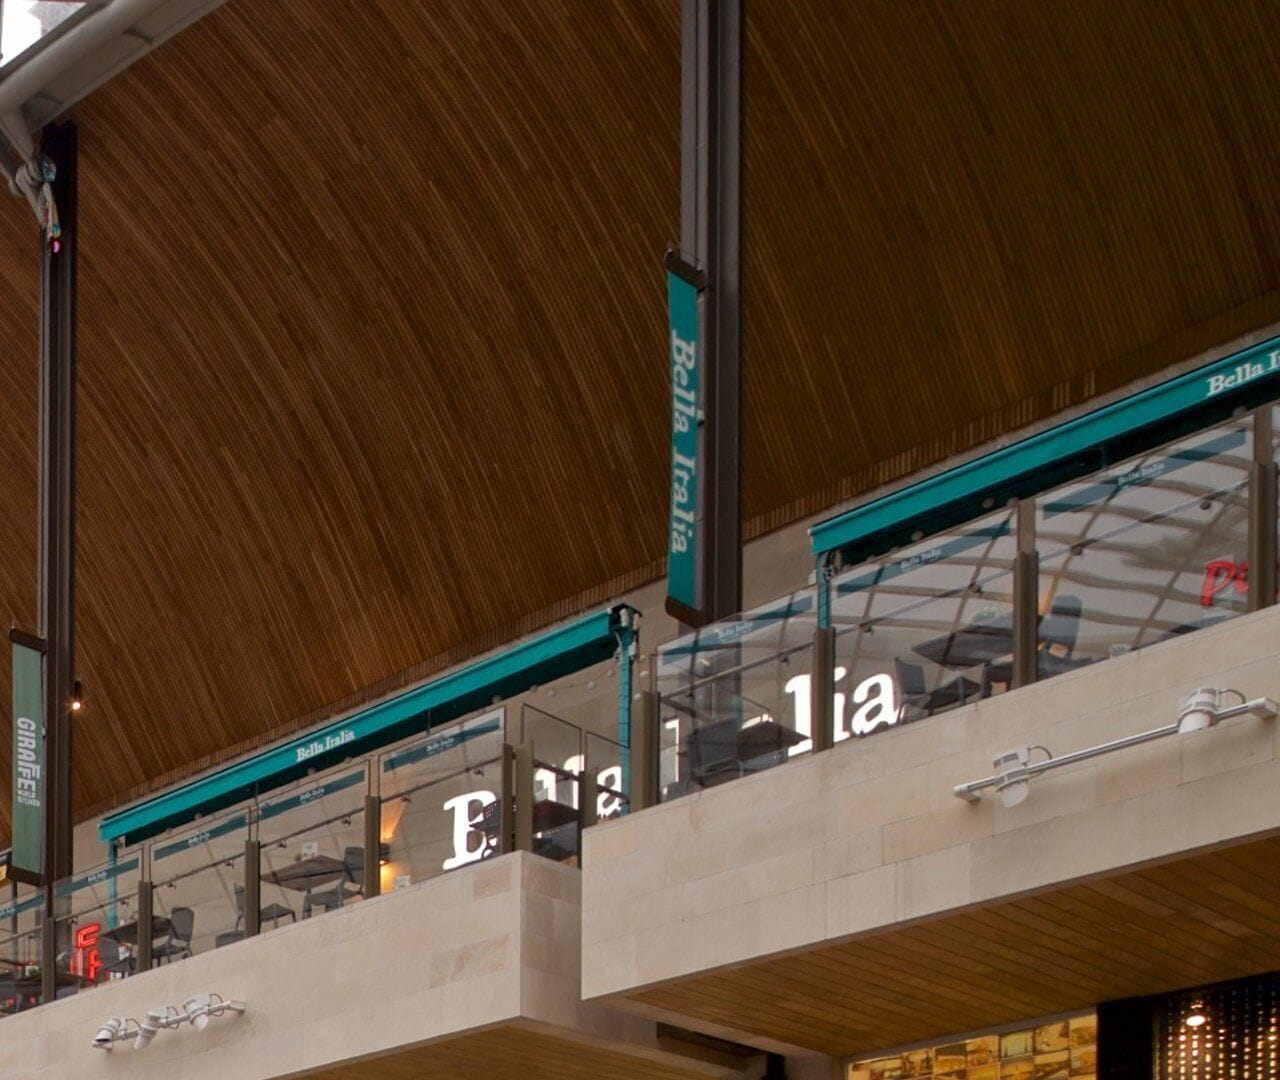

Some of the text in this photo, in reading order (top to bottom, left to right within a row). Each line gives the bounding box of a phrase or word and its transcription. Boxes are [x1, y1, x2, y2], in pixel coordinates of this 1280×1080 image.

[1207, 357, 1266, 398] Bella
[672, 329, 695, 553] Bella Italia
[17, 717, 40, 793] GIRAFFE
[296, 729, 355, 762] Bella Italia
